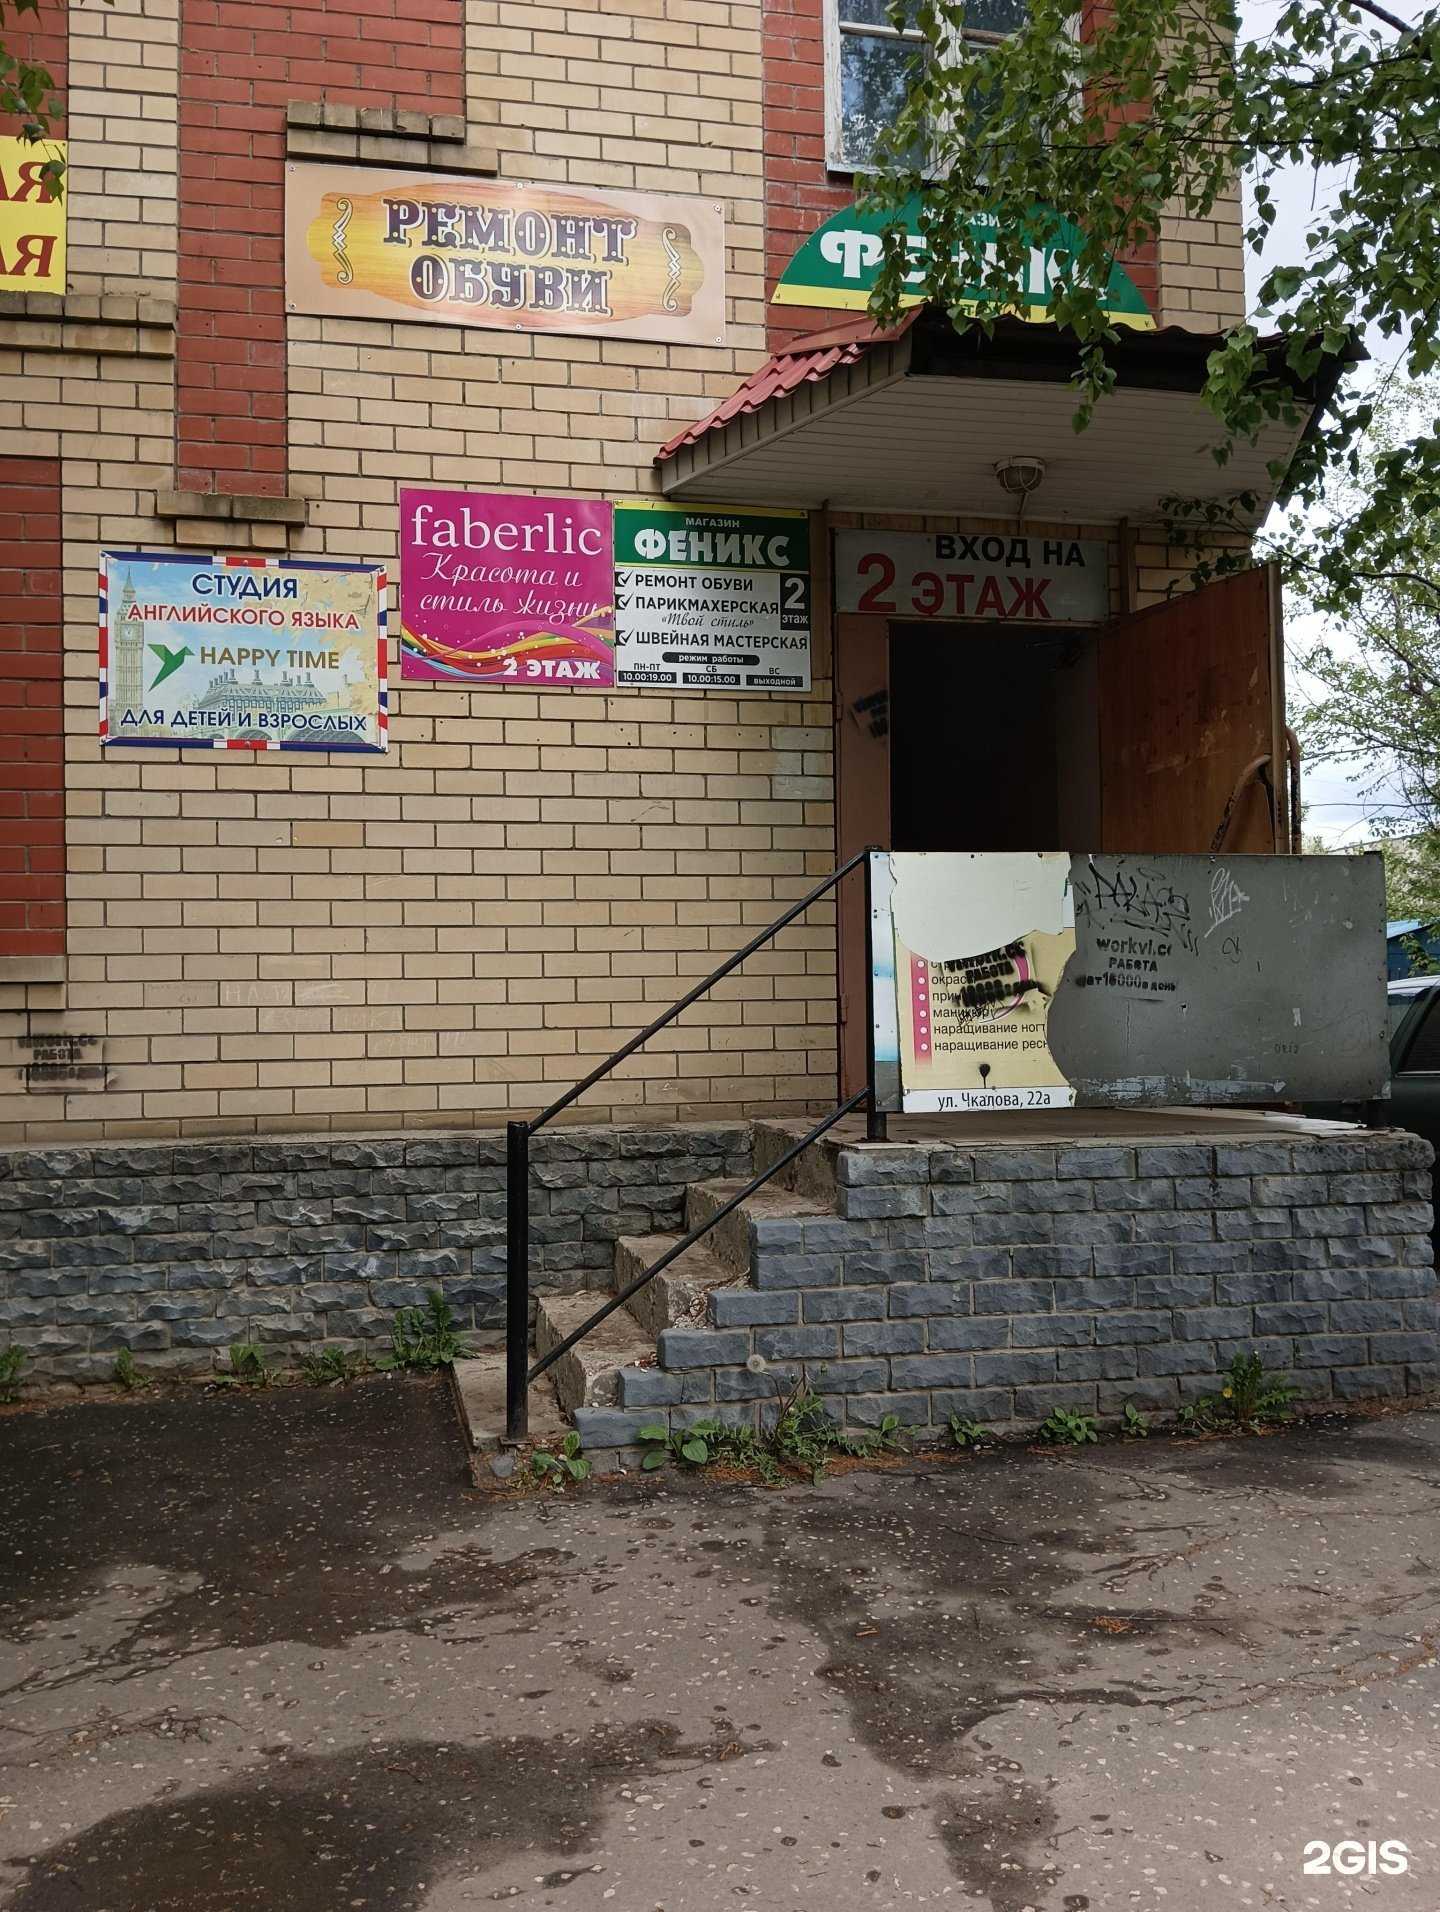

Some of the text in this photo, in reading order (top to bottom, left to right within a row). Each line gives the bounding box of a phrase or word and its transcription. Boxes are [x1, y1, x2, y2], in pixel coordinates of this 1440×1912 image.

[383, 198, 639, 266] РЕМОНТ
[410, 254, 613, 317] ОБУВИ
[411, 504, 602, 556] faberlic
[685, 517, 740, 528] МАГАЗИН
[634, 528, 790, 566] ФЕНИКС
[935, 534, 1086, 569] ВХОД НА
[420, 552, 583, 587] Красота и
[192, 573, 298, 600] СТУДИЯ
[635, 574, 753, 591] РЕМОНТ ОБУВИ
[856, 553, 1052, 618] 2 ЭТАЖ
[420, 593, 509, 613] стиль
[784, 577, 805, 610] 2
[635, 596, 779, 615] ПАРИКМАХЕРСКАЯ
[127, 603, 360, 630] АНГЛИЙСКОГО ЯЗЫКА
[635, 630, 808, 650] ШВЕЙНАЯ МАСТЕРСКАЯ
[200, 646, 340, 670] HAPPY TIME
[633, 662, 661, 671] ПН-ПТ
[678, 654, 744, 664] режим работы
[502, 657, 601, 680] 2 ЭТАЖ
[622, 672, 672, 682] 10.00:19.00
[705, 665, 718, 673] СБ
[768, 667, 780, 675] ВС
[687, 675, 736, 684] 10.00:15.00
[753, 677, 796, 686] выходной
[120, 708, 367, 731] ДЛЯ ДЕТЕЙ И ВЗРОСЛЫХ
[934, 1023, 1018, 1036] наращивание
[934, 1040, 1019, 1051] наращивание
[937, 1091, 1051, 1111] ул. Чкалова, 22а
